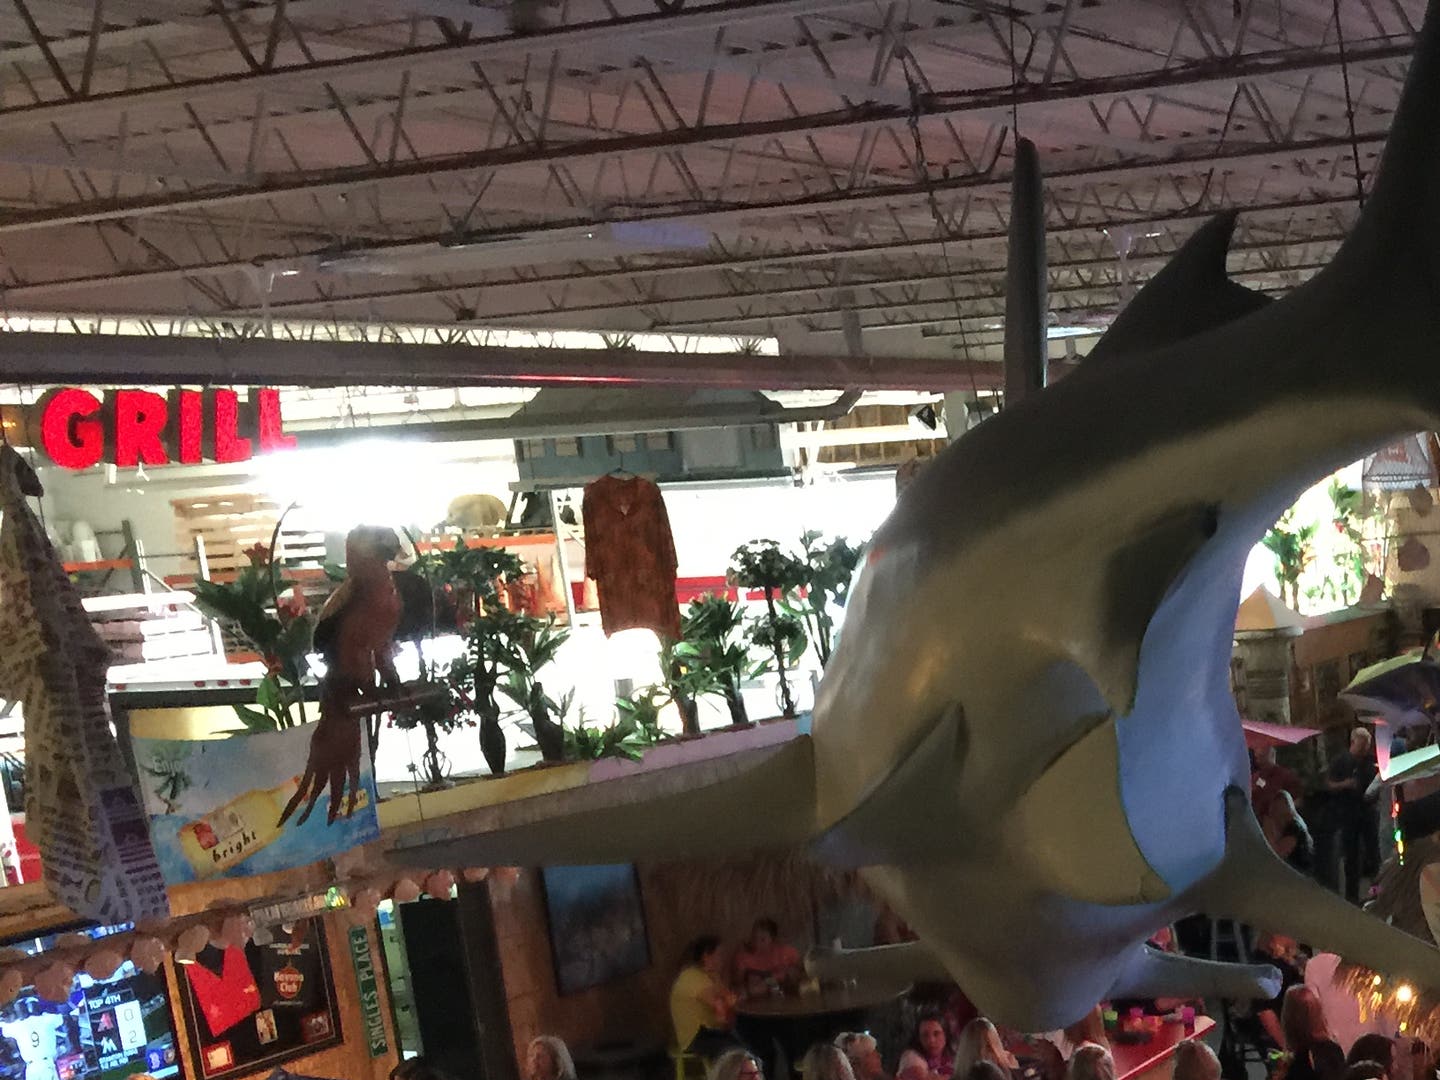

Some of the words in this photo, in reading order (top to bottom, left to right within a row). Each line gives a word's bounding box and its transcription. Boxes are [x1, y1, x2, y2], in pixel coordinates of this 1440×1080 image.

[41, 387, 297, 470] GRILL
[211, 831, 257, 863] bright
[88, 999, 104, 1010] TOP
[105, 994, 121, 1006] 4TH
[363, 990, 388, 1050] SINGLES
